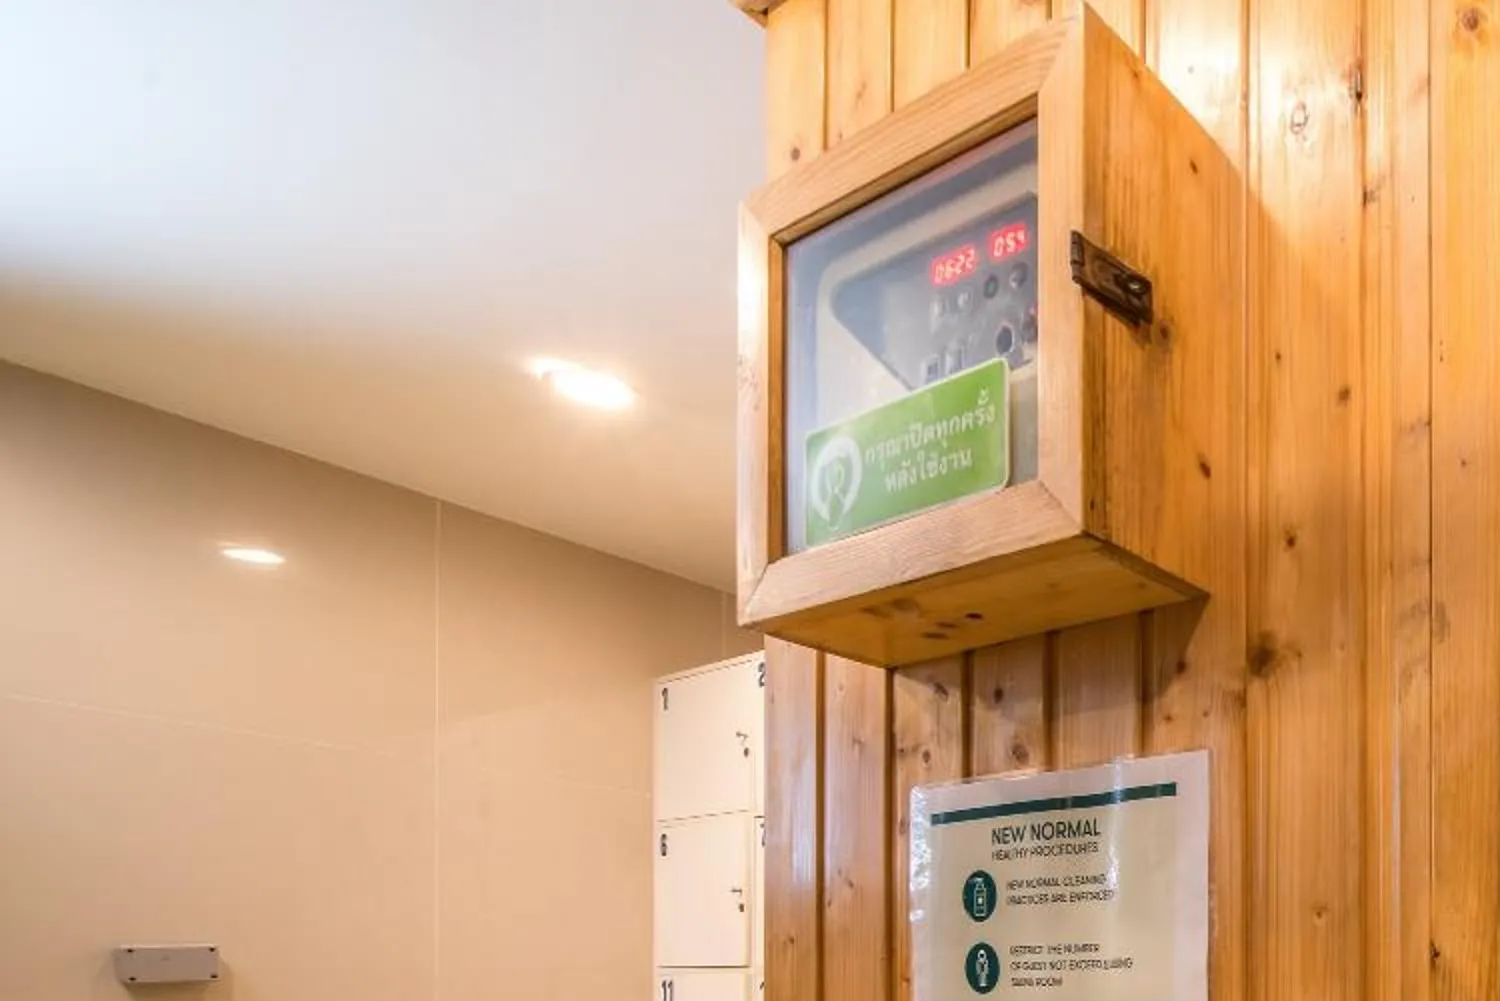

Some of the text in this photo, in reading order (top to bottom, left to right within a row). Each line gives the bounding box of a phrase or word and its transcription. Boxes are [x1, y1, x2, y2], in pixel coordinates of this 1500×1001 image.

[661, 687, 669, 711] 1
[992, 818, 1102, 845] NEW NORMAL
[660, 833, 668, 856] 6
[991, 841, 1100, 861] HEALTHY PROCEDURES
